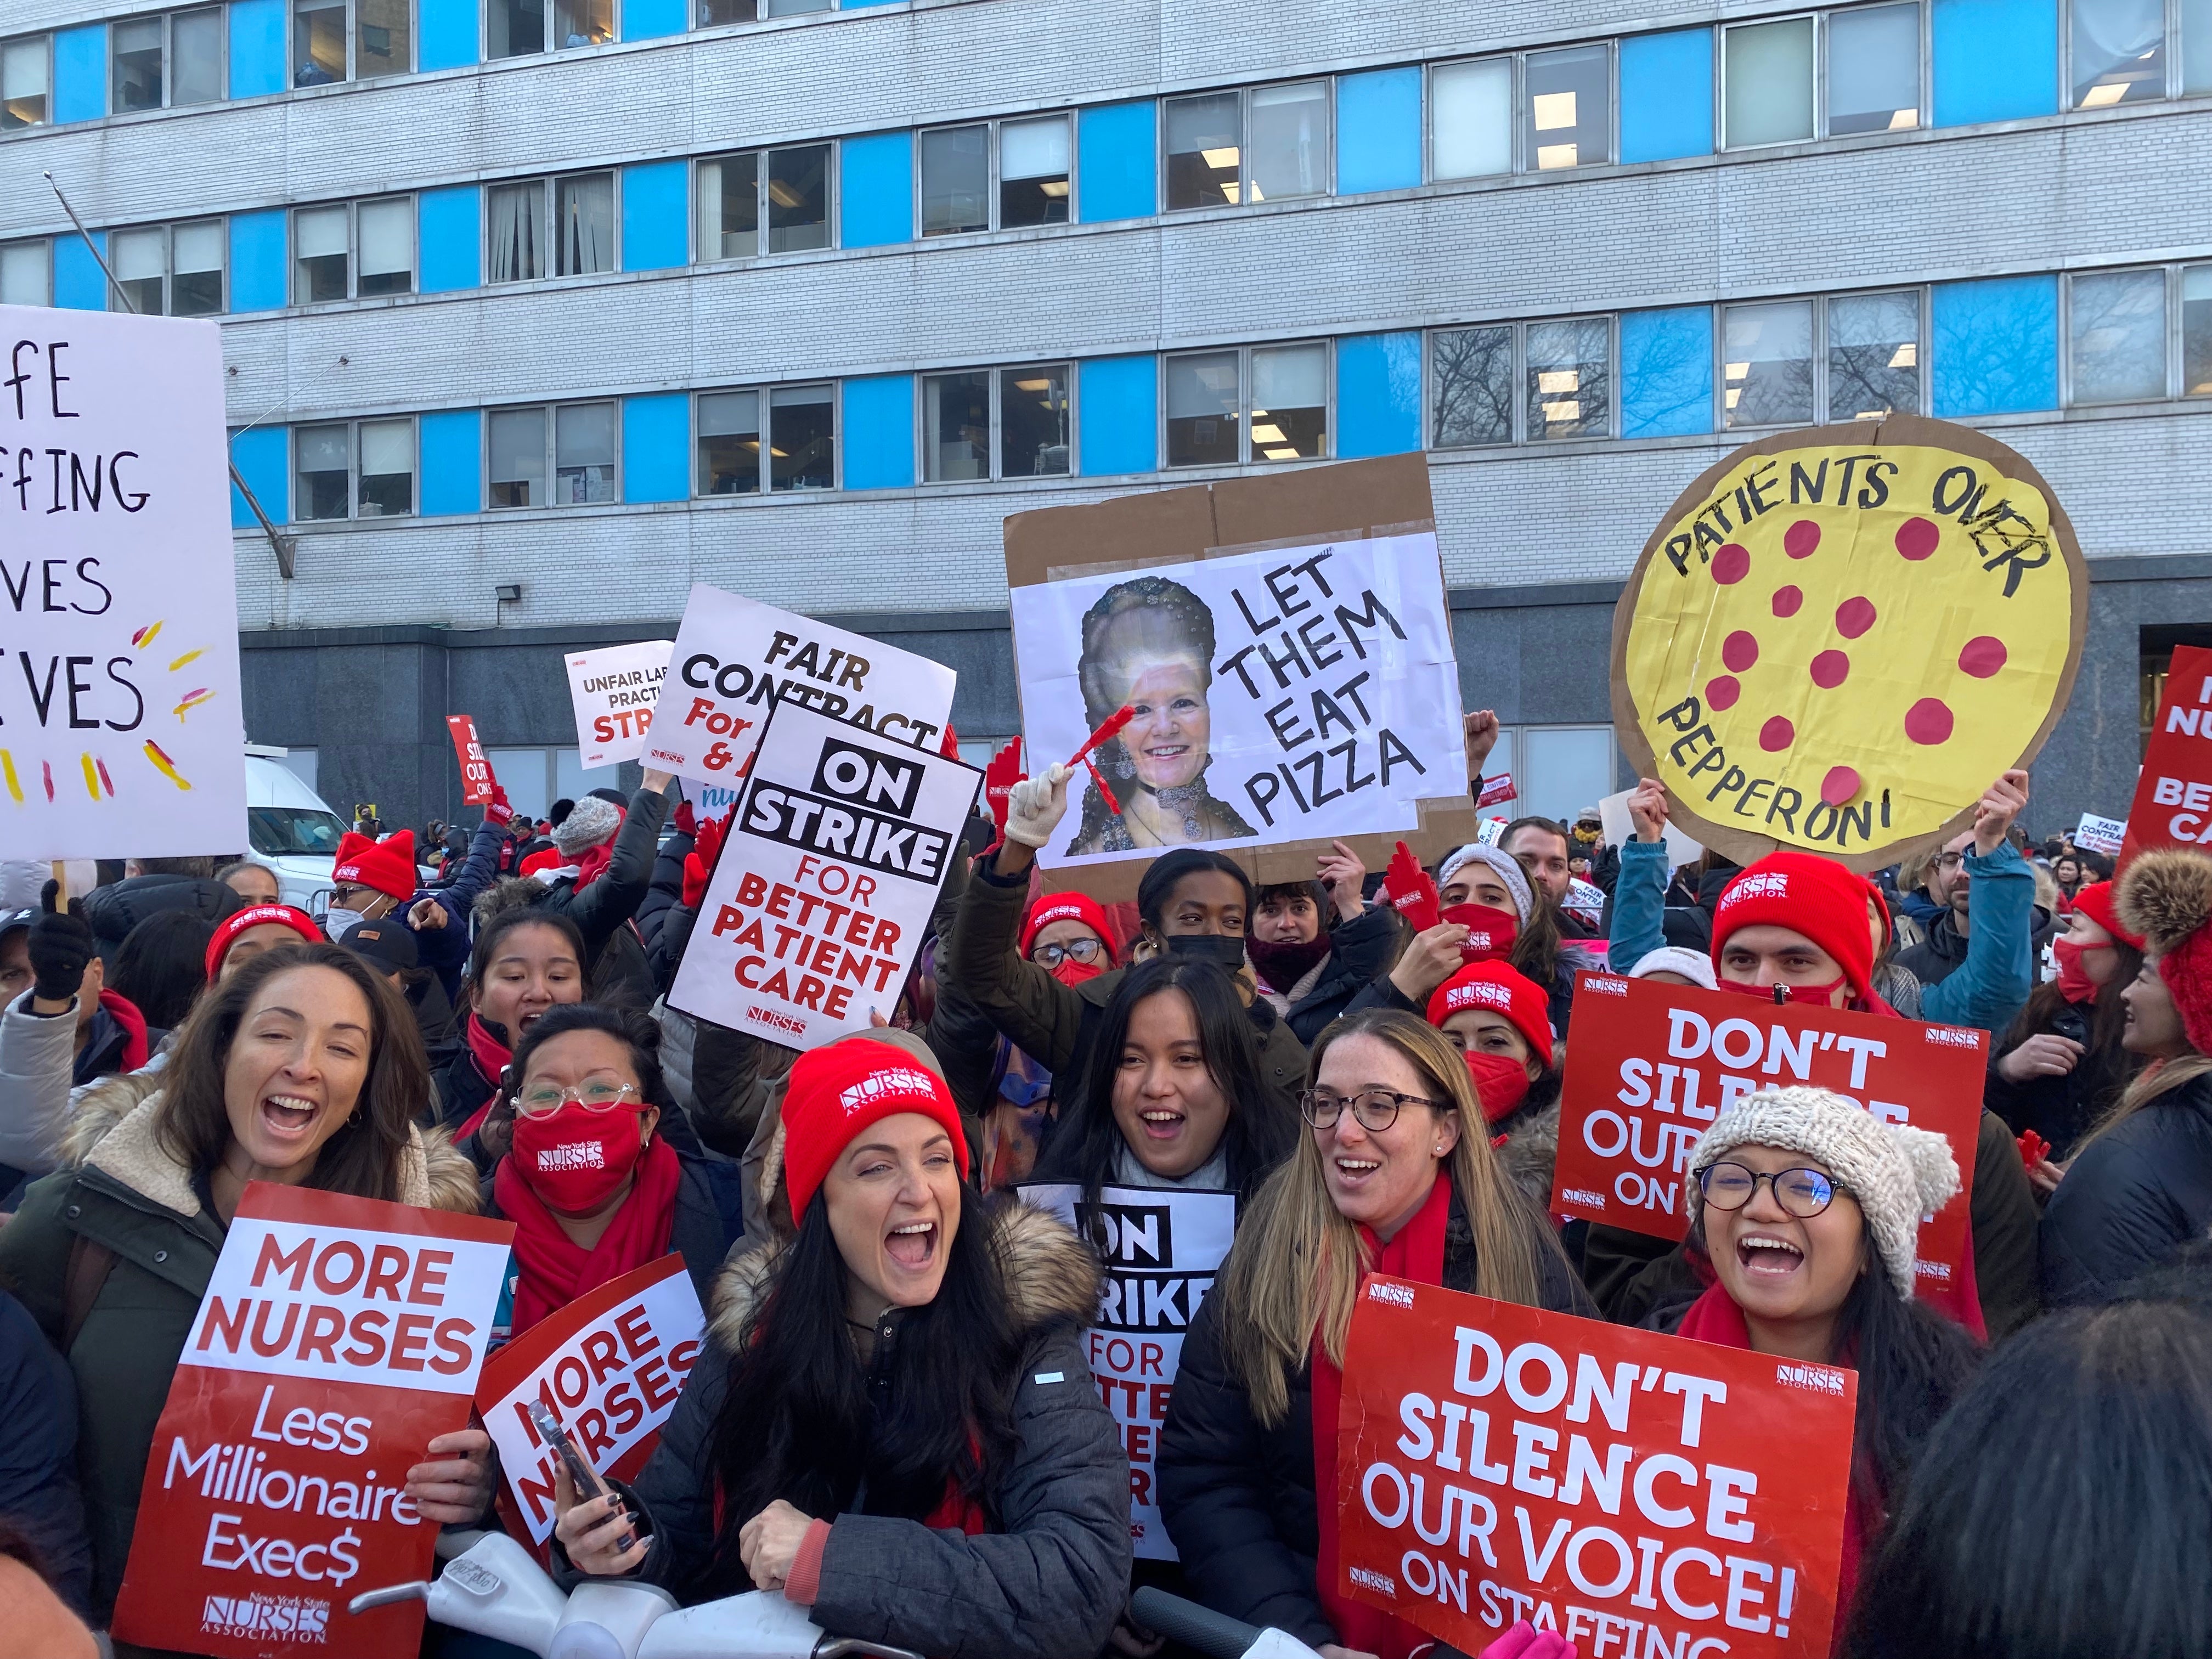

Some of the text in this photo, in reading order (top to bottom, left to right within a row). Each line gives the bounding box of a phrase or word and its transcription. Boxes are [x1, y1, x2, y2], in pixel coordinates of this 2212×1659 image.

[3, 340, 80, 420] fE
[1664, 455, 2051, 598] PATIENTS OVER
[0, 557, 111, 615] VES
[1231, 547, 1335, 637] LET
[764, 630, 870, 691] FAIR
[1217, 589, 1407, 699] THEM
[0, 648, 144, 732] VES
[583, 671, 643, 693] UNFAIR
[594, 708, 653, 743] STR
[684, 697, 753, 739] For
[1265, 670, 1372, 752] EAT
[466, 763, 488, 781] OUR
[703, 742, 733, 770] &
[1657, 696, 1891, 847] PEPPERONI
[477, 783, 489, 795] ON
[823, 750, 912, 810] ON
[1244, 728, 1426, 827] PIZZA
[748, 788, 945, 878] STRIKE
[2098, 821, 2120, 832] FAIR
[794, 855, 876, 907] FOR
[1584, 885, 1602, 899] FAIR
[1720, 877, 1788, 912] NURSES
[736, 872, 901, 956] BETTER
[1395, 892, 1421, 907] NURSES
[712, 904, 901, 993] PATIENT
[734, 955, 854, 1020] CARE
[1447, 985, 1511, 1003] NURSES
[1583, 988, 1628, 997] ASSOCIATION
[1584, 978, 1628, 993] NURSES
[746, 1005, 808, 1034] NURSES
[1448, 997, 1511, 1012] ASSOCIATION
[744, 1017, 804, 1040] ASSOCIATION
[1925, 1038, 1979, 1050] ASSOCIATION
[1926, 1028, 1980, 1045] NURSES
[1668, 1008, 1887, 1091] DON'T
[869, 1068, 891, 1078] New
[890, 1067, 910, 1075] York
[840, 1074, 933, 1110] NURSES
[846, 1087, 938, 1117] ASSOCIATION
[538, 1146, 602, 1166] NURSES
[538, 1158, 605, 1172] ASSOCIATION
[1561, 1198, 1605, 1211] ASSOCIATION
[1562, 1188, 1606, 1206] NURSES
[1615, 1172, 1679, 1215] ON
[250, 1233, 454, 1307] MORE
[1368, 1295, 1413, 1310] ASSOCIATION
[1369, 1283, 1415, 1305] NURSES
[196, 1296, 476, 1375] NURSES
[1090, 1334, 1164, 1377] FOR
[1801, 1364, 1815, 1372] New
[1816, 1366, 1830, 1375] York
[513, 1303, 661, 1449] MORE
[1453, 1326, 1727, 1448] DON'T
[1776, 1378, 1844, 1397] ASSOCIATION
[1777, 1365, 1844, 1391] NURSES
[251, 1385, 372, 1455] Less
[163, 1436, 422, 1526] Millionaire
[1396, 1392, 1756, 1544] SILENCE
[202, 1513, 362, 1588] Exec$
[1362, 1462, 1796, 1639] OUR VOICE!
[1350, 1566, 1395, 1594] NURSES
[1350, 1579, 1397, 1600] ASSOCIATION
[1401, 1550, 1469, 1615] ON
[202, 1595, 329, 1633] NURSES
[249, 1591, 330, 1610] New York State
[200, 1622, 327, 1644] ASSOCIATION
